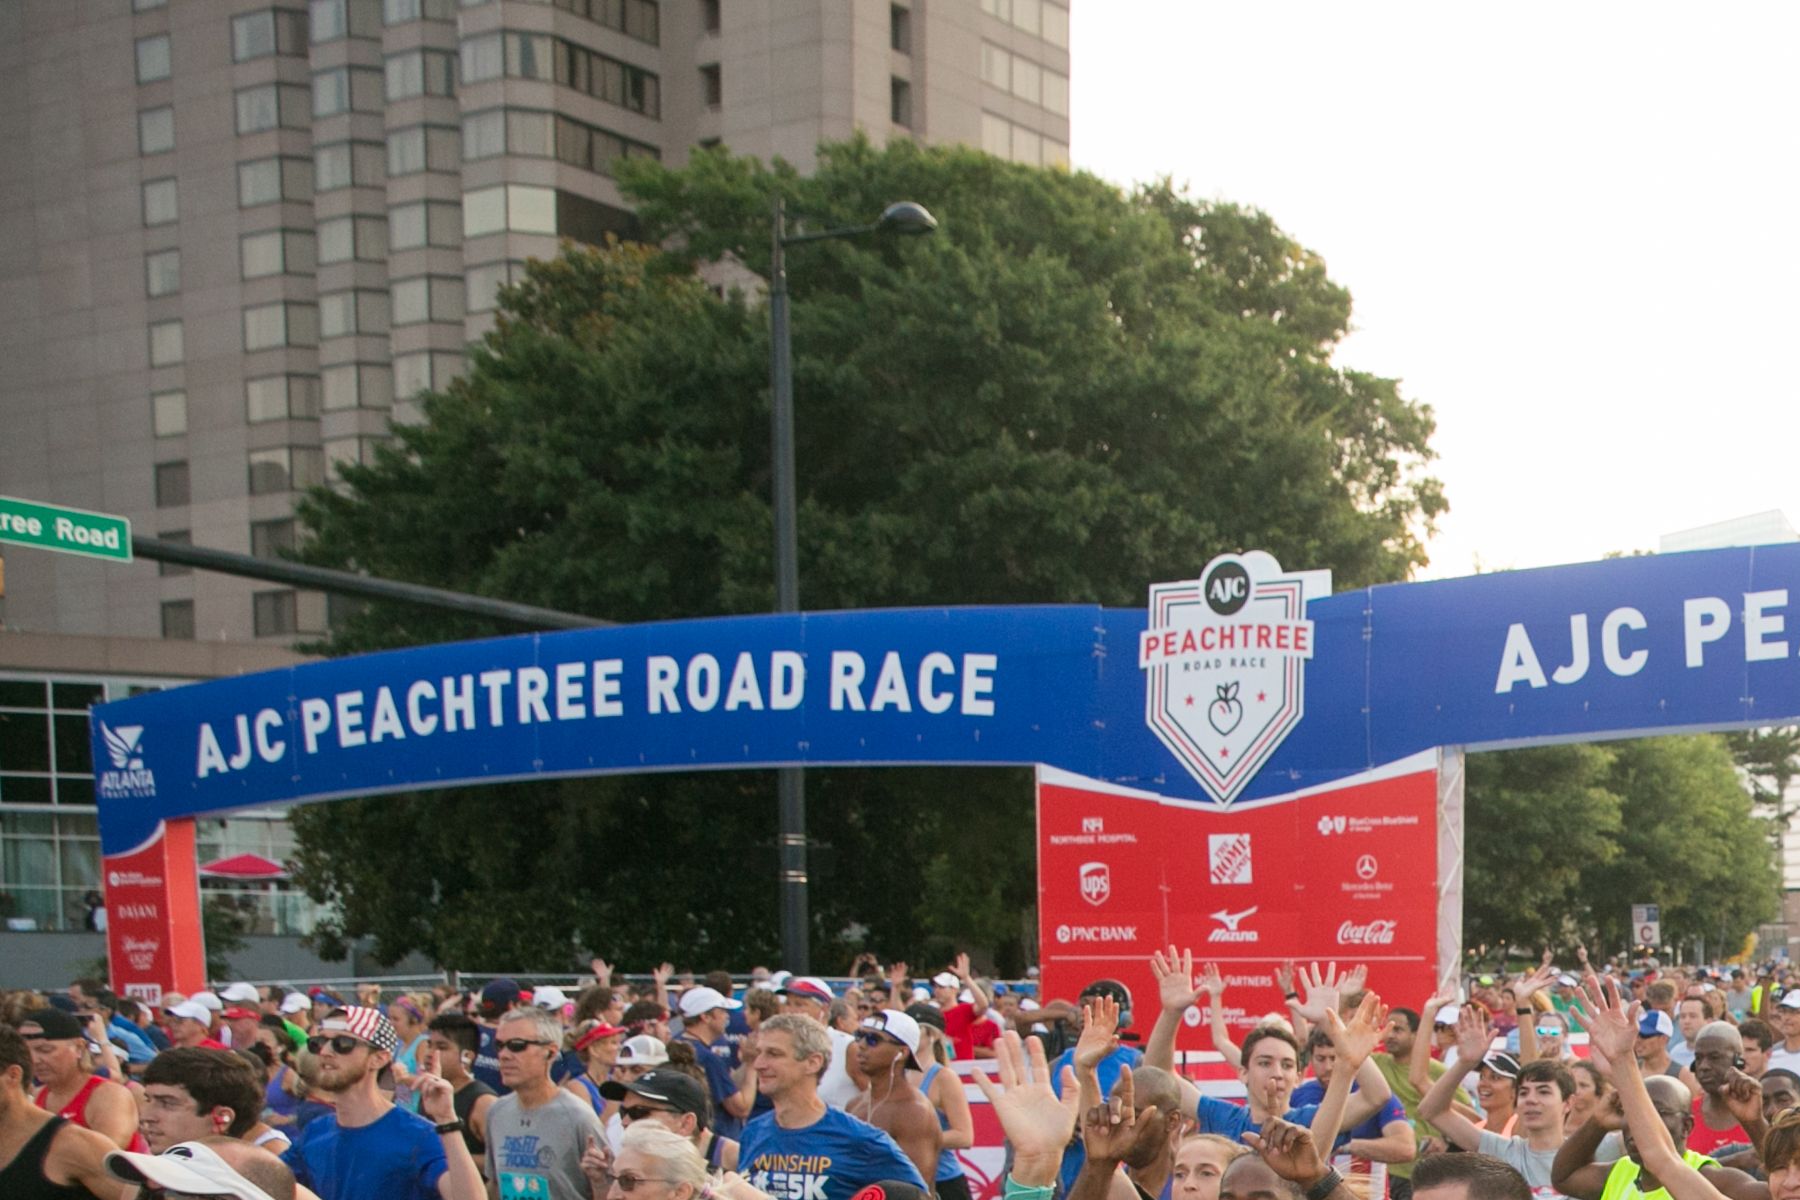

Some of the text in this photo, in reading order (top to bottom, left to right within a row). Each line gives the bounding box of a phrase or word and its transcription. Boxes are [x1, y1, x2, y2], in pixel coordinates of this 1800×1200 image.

[0, 512, 119, 549] ree Road
[1210, 576, 1246, 603] AJC
[1146, 624, 1308, 660] PEACHTREE
[1494, 607, 1649, 693] AJC
[1183, 657, 1266, 673] ROAD RACE
[197, 651, 998, 778] AJC PEACHTREE ROAD RACE
[101, 770, 156, 790] ATLANTA
[1211, 837, 1250, 884] HOME
[1084, 875, 1108, 899] ups
[754, 1154, 832, 1174] WINSHIP
